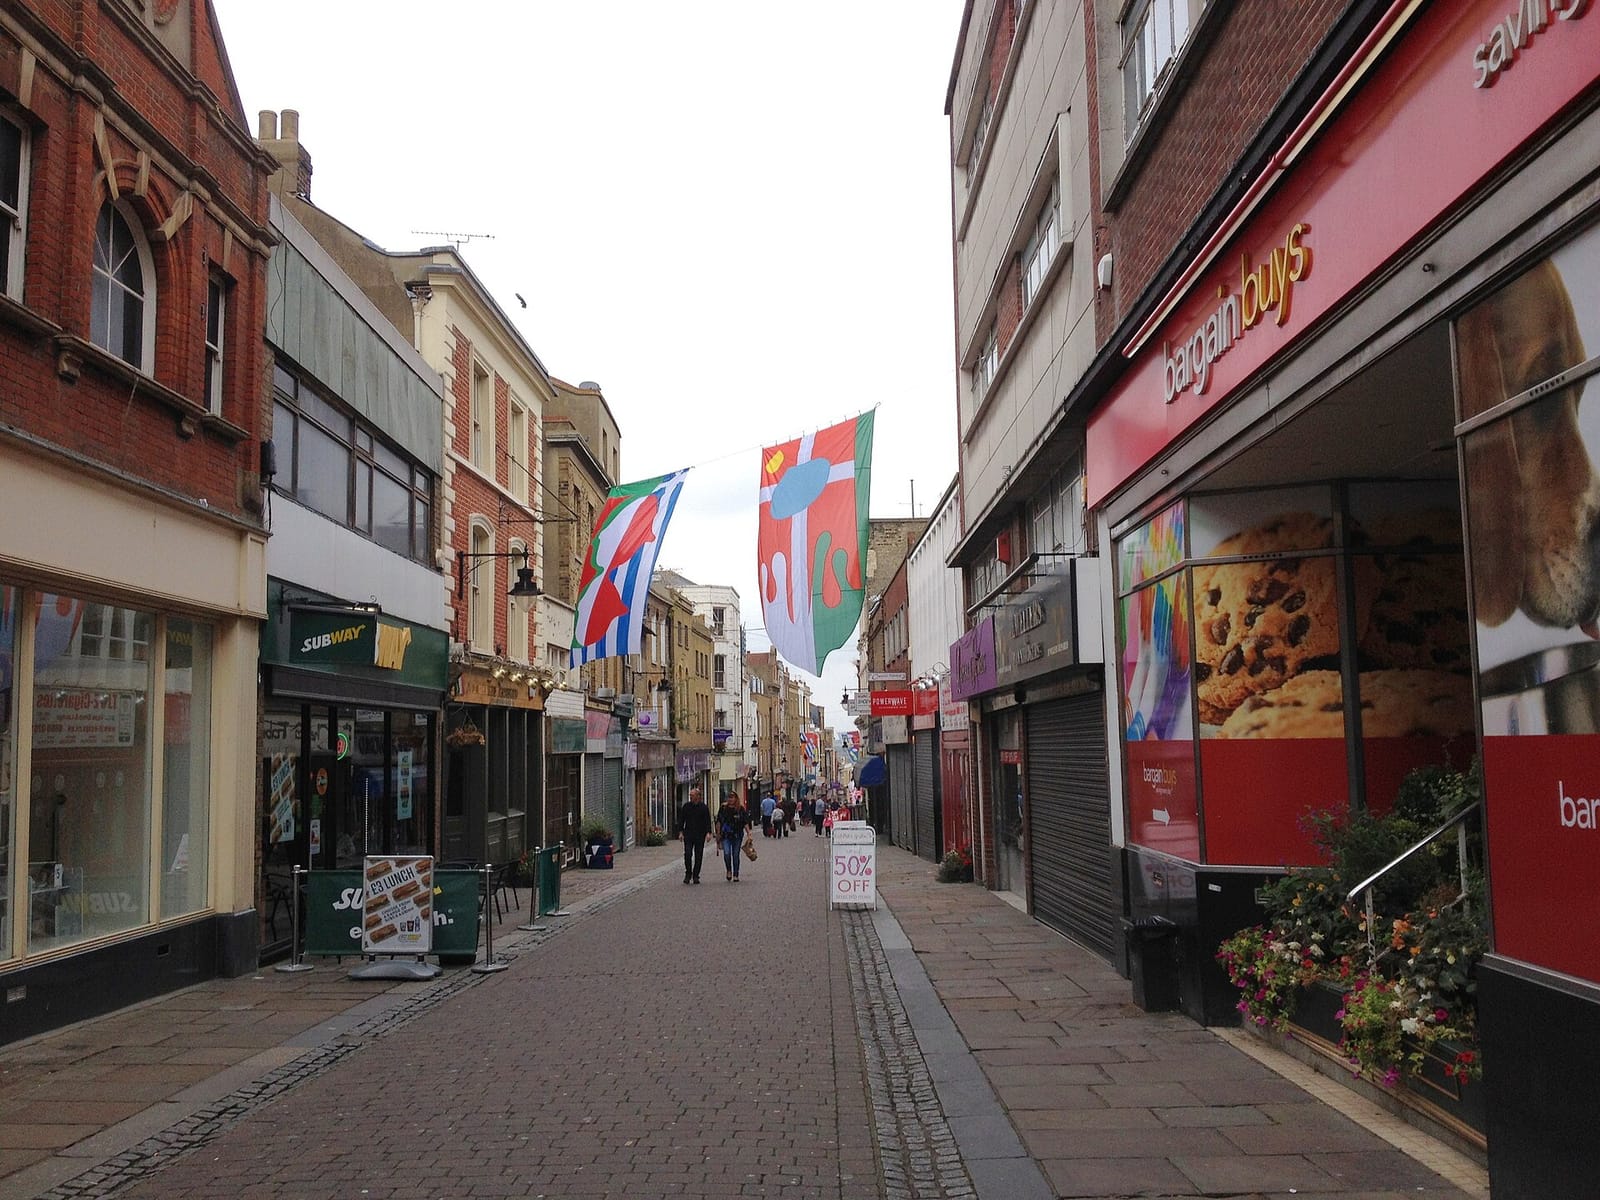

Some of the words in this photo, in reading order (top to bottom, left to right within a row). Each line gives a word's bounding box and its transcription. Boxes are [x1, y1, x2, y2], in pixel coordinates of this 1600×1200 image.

[1163, 285, 1243, 404] bargain
[1241, 223, 1308, 331] buys
[301, 624, 366, 653] SUBWAY
[872, 697, 907, 706] POWERWAVE
[834, 855, 873, 876] 50%
[370, 881, 384, 895] £3
[382, 867, 415, 890] LUNCH
[838, 880, 870, 892] OFF
